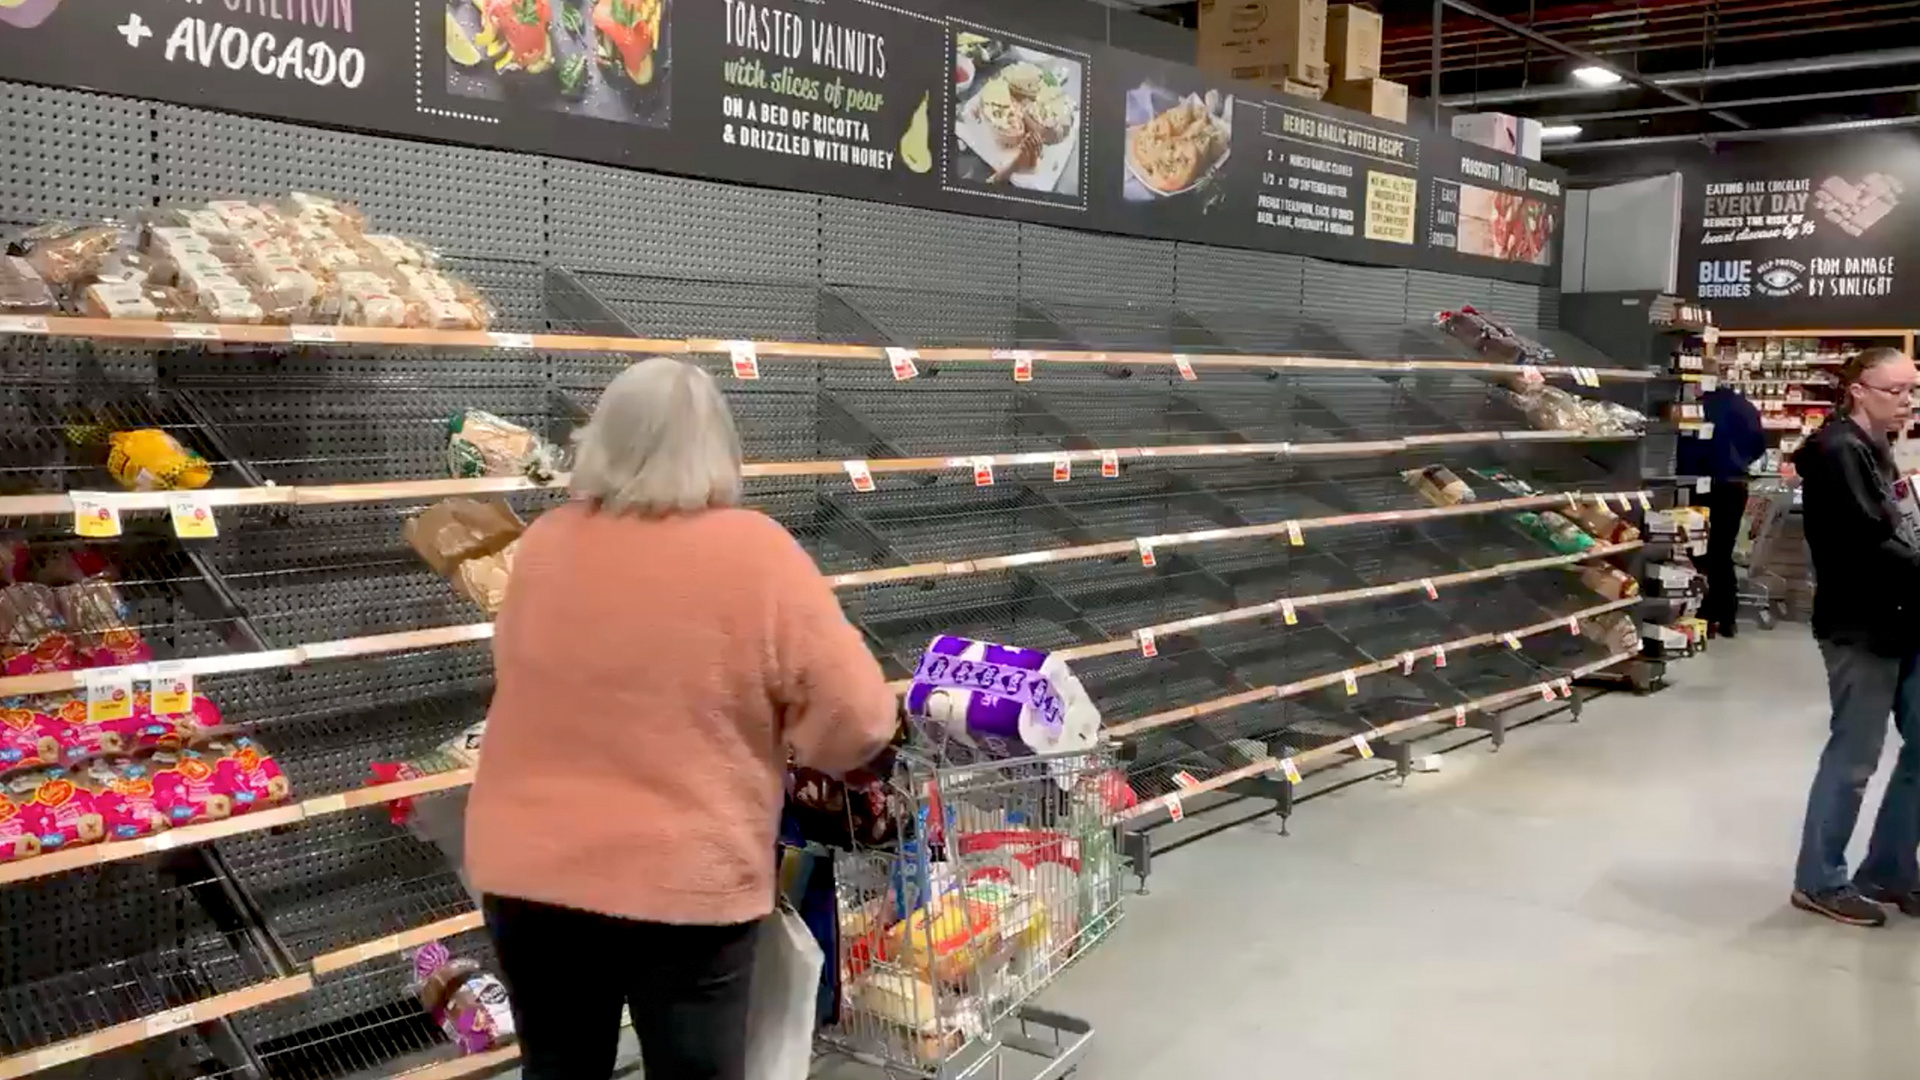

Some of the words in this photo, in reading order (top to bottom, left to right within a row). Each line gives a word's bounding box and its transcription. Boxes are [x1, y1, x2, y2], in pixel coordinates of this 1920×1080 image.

[723, 0, 802, 59] TOASTED
[811, 19, 887, 79] WALNUTS
[164, 16, 366, 89] AVOCADO
[724, 57, 767, 89] with
[771, 64, 820, 101] slices
[824, 77, 844, 108] of
[845, 88, 884, 112] pear
[722, 96, 743, 118] ON
[747, 100, 757, 121] A
[761, 103, 787, 126] BED
[791, 109, 809, 130] OF
[813, 114, 870, 142] RICOTTA
[722, 124, 736, 144] &
[740, 126, 810, 157] DRIZZLED
[814, 139, 848, 164] WITH
[851, 146, 894, 171] HONEY
[1283, 113, 1315, 138] HERBED
[1317, 122, 1347, 144] GARLIC
[1347, 130, 1377, 152] BUTTER
[1378, 136, 1404, 158] RECIPE
[1705, 182, 1744, 196] EATING
[1767, 178, 1811, 193] CHOCOLATE
[1704, 195, 1765, 217] EVERY
[1770, 192, 1809, 213] DAY
[1702, 216, 1744, 228] REDUCES
[1746, 215, 1765, 226] THE
[1766, 214, 1789, 226] RISK
[1791, 214, 1804, 225] OF
[1701, 230, 1736, 245] heart
[1735, 227, 1781, 241] disease
[1782, 223, 1799, 240] by
[1699, 260, 1752, 283] BLUE
[1810, 256, 1841, 275] FROM
[1845, 256, 1895, 275] DAMAGE
[1697, 283, 1751, 298] BERRIES
[1808, 276, 1825, 297] BY
[1830, 275, 1894, 296] SUNLIGHT
